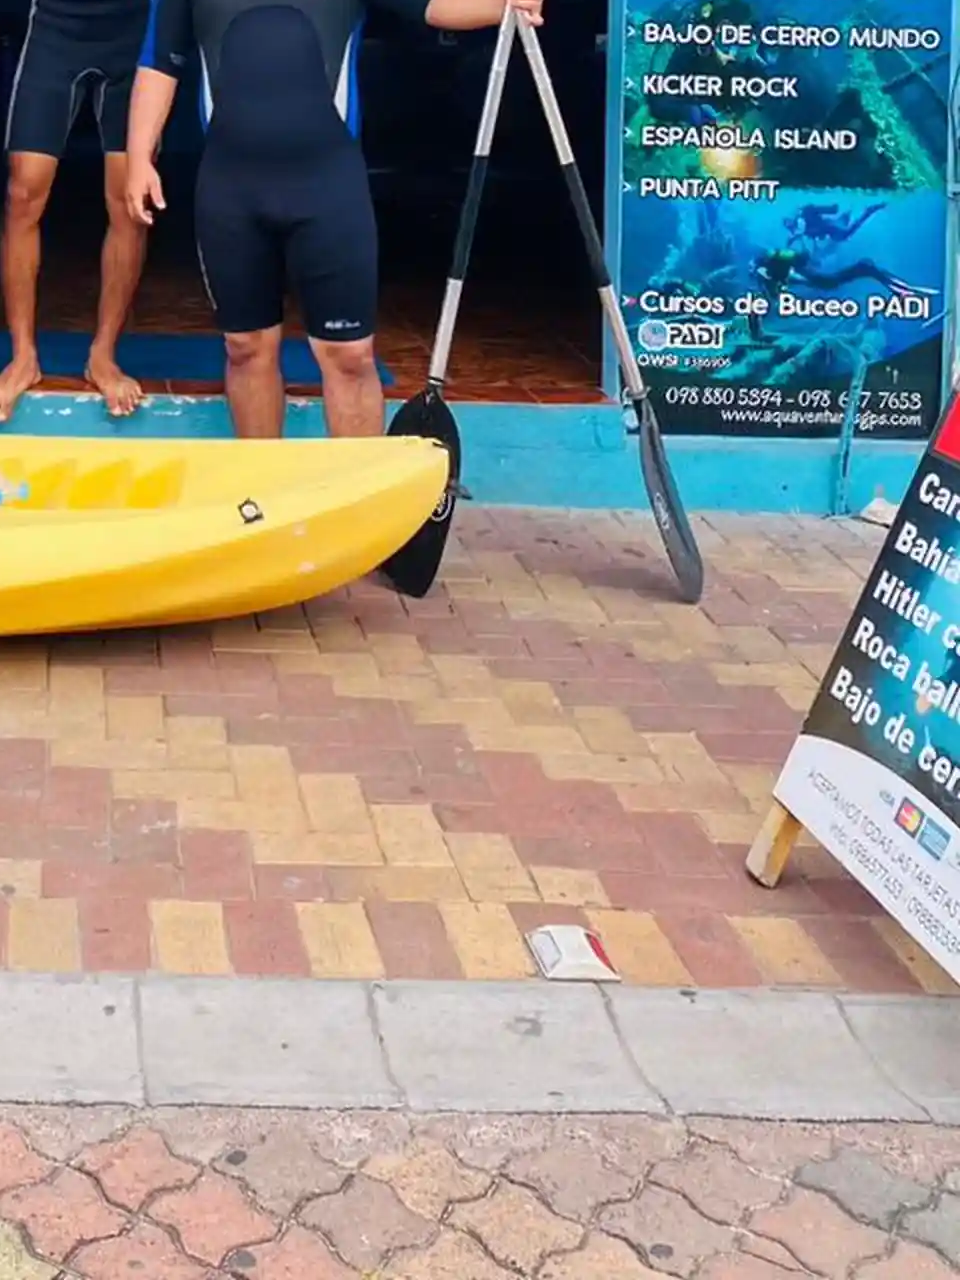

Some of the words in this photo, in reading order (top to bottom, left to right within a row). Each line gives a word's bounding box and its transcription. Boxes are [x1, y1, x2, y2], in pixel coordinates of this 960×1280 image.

[643, 23, 713, 45] BAJO
[721, 24, 753, 45] DE
[760, 25, 841, 47] CERRO
[848, 27, 941, 50] MUNDO
[642, 75, 723, 96] KICKER
[730, 76, 799, 98] ROCK
[641, 125, 766, 148] ESPAÑOLA
[774, 129, 857, 151] ISLAND
[640, 177, 721, 198] PUNTA
[728, 179, 780, 200] PITT
[639, 290, 725, 314] Cursos
[735, 292, 769, 315] de
[778, 294, 858, 317] Buceo
[867, 296, 930, 319] PADI
[669, 326, 720, 346] PADI
[665, 386, 700, 405] 098
[702, 387, 736, 405] 880
[798, 389, 832, 408] 098
[838, 390, 872, 409] 67
[919, 472, 960, 524] Car
[873, 570, 942, 636] Hitler
[851, 616, 912, 682] Roca
[829, 665, 882, 726] Bajo
[883, 712, 916, 755] de
[918, 744, 960, 801] cer
